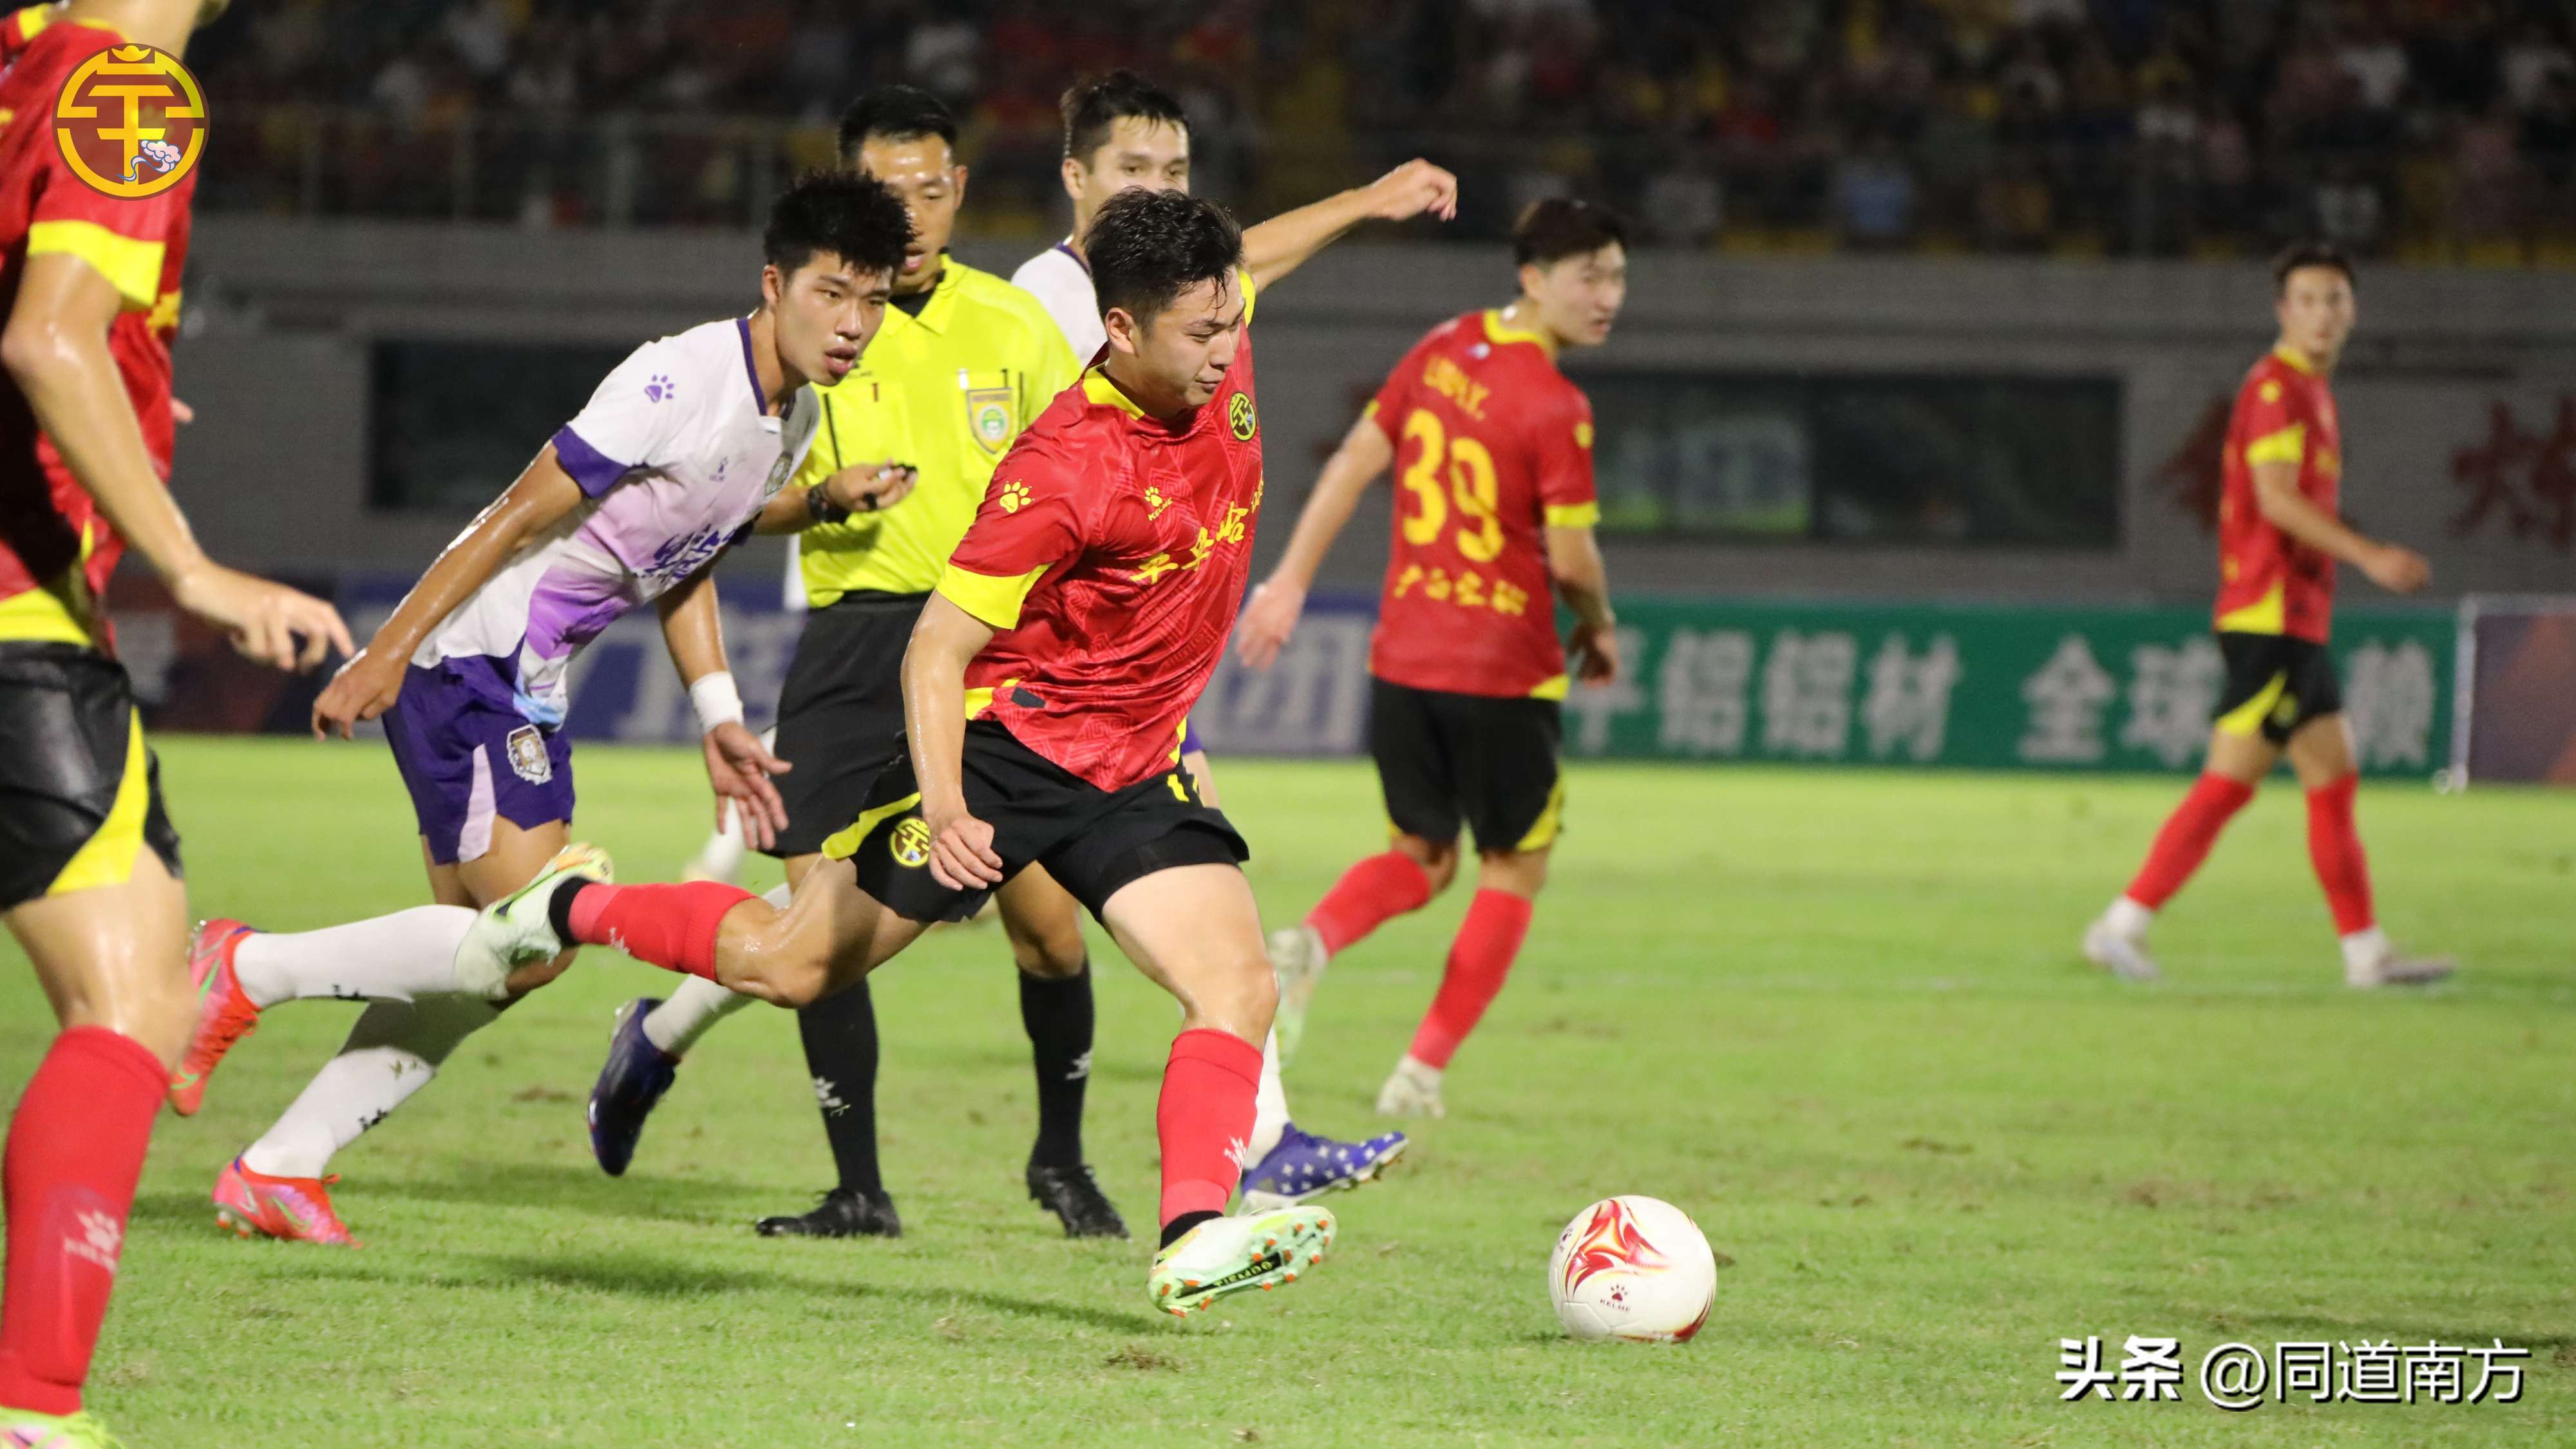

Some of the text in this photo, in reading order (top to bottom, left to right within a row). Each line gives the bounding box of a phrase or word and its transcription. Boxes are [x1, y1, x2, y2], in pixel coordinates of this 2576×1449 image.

[1403, 408, 1504, 562] 39
[2017, 633, 2436, 768] 全球赖
